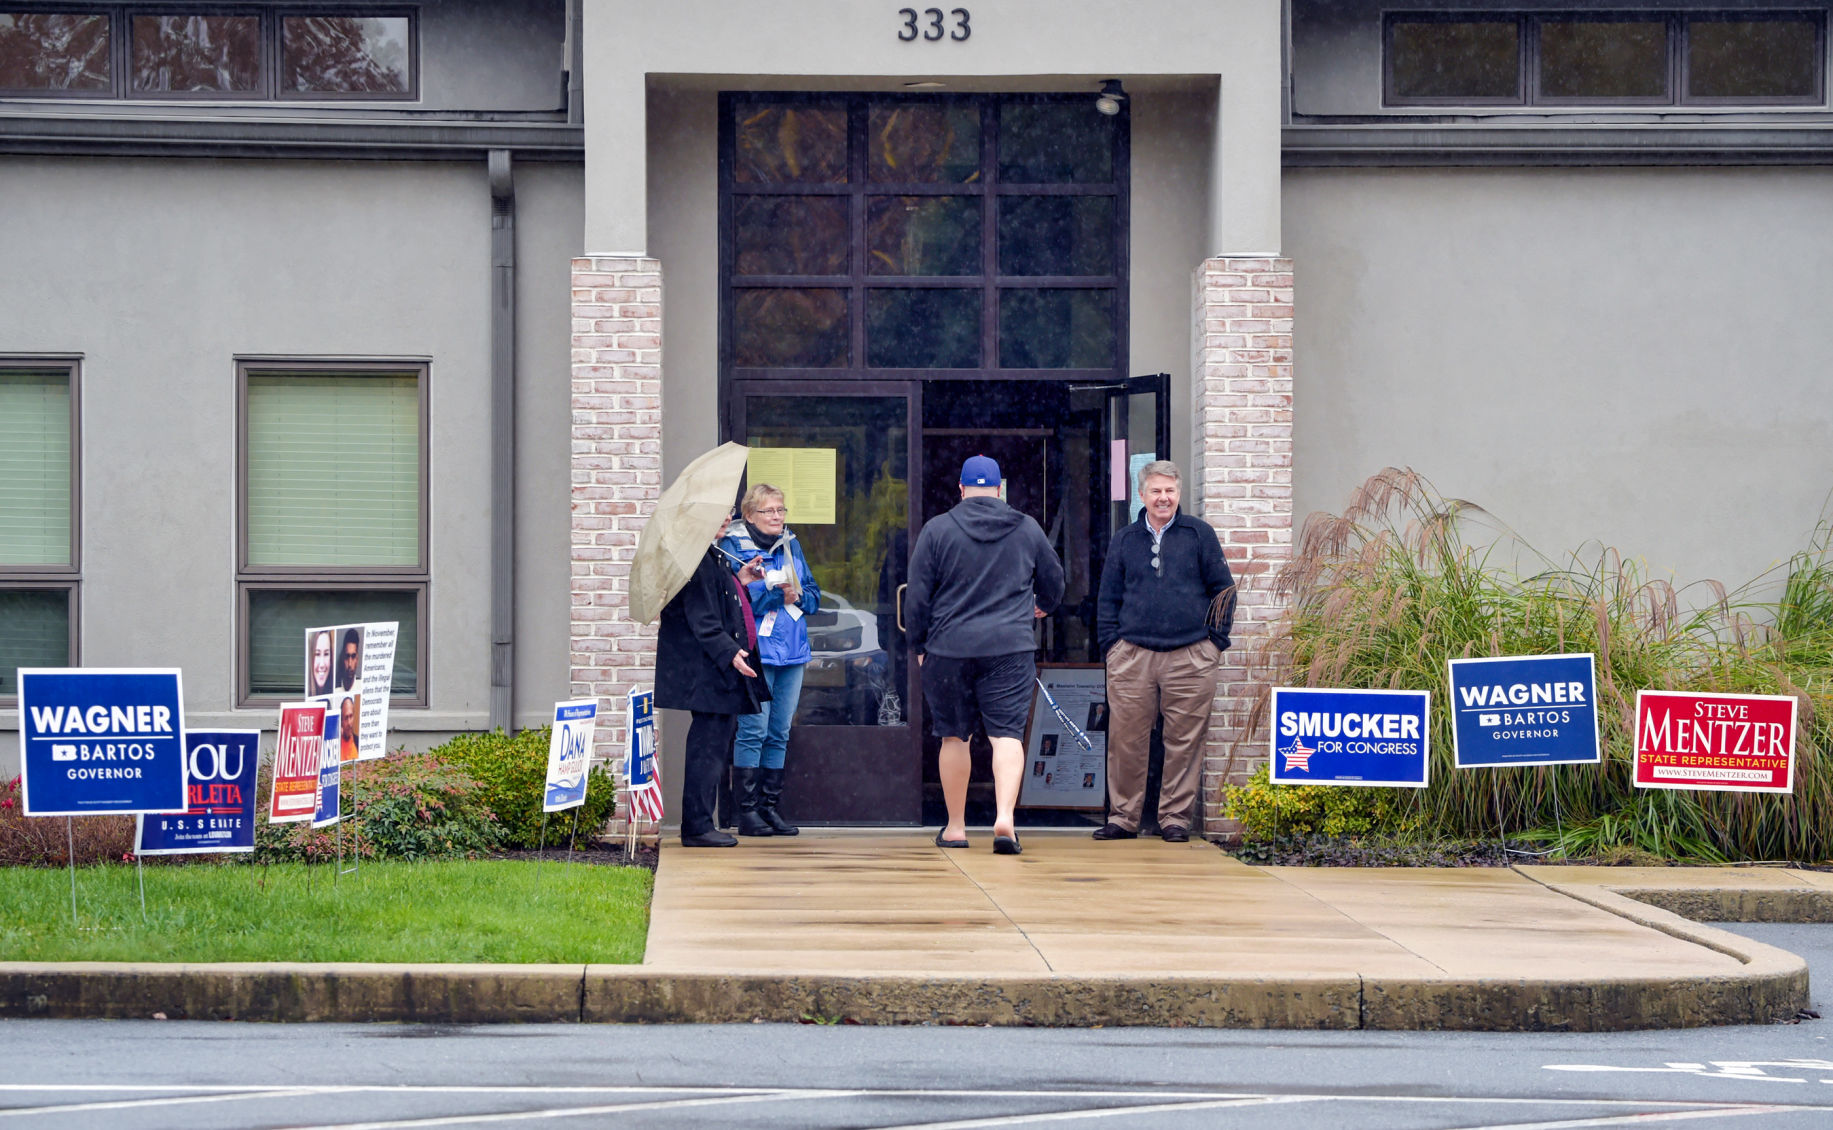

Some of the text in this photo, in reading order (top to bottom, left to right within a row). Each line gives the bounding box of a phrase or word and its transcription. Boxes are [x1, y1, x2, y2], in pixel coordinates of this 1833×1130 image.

[898, 8, 971, 41] 333
[1460, 682, 1586, 707] WAGNER
[30, 705, 173, 733] WAGNER
[1504, 711, 1570, 725] BARTOS
[1694, 701, 1749, 719] STEVE
[297, 714, 315, 733] STEVE
[1280, 711, 1420, 739] SMUCKER
[1640, 707, 1788, 757] MENTZER
[560, 724, 586, 761] DANA
[1493, 729, 1559, 740] GOVERNOR
[80, 744, 155, 761] BARTOS
[1318, 741, 1417, 755] FOR CONGRESS
[188, 744, 246, 780] OU
[1640, 754, 1787, 769] STATE REPRESENTATIVE
[67, 768, 142, 780] GOVERNOR
[188, 784, 243, 805] RLETTA
